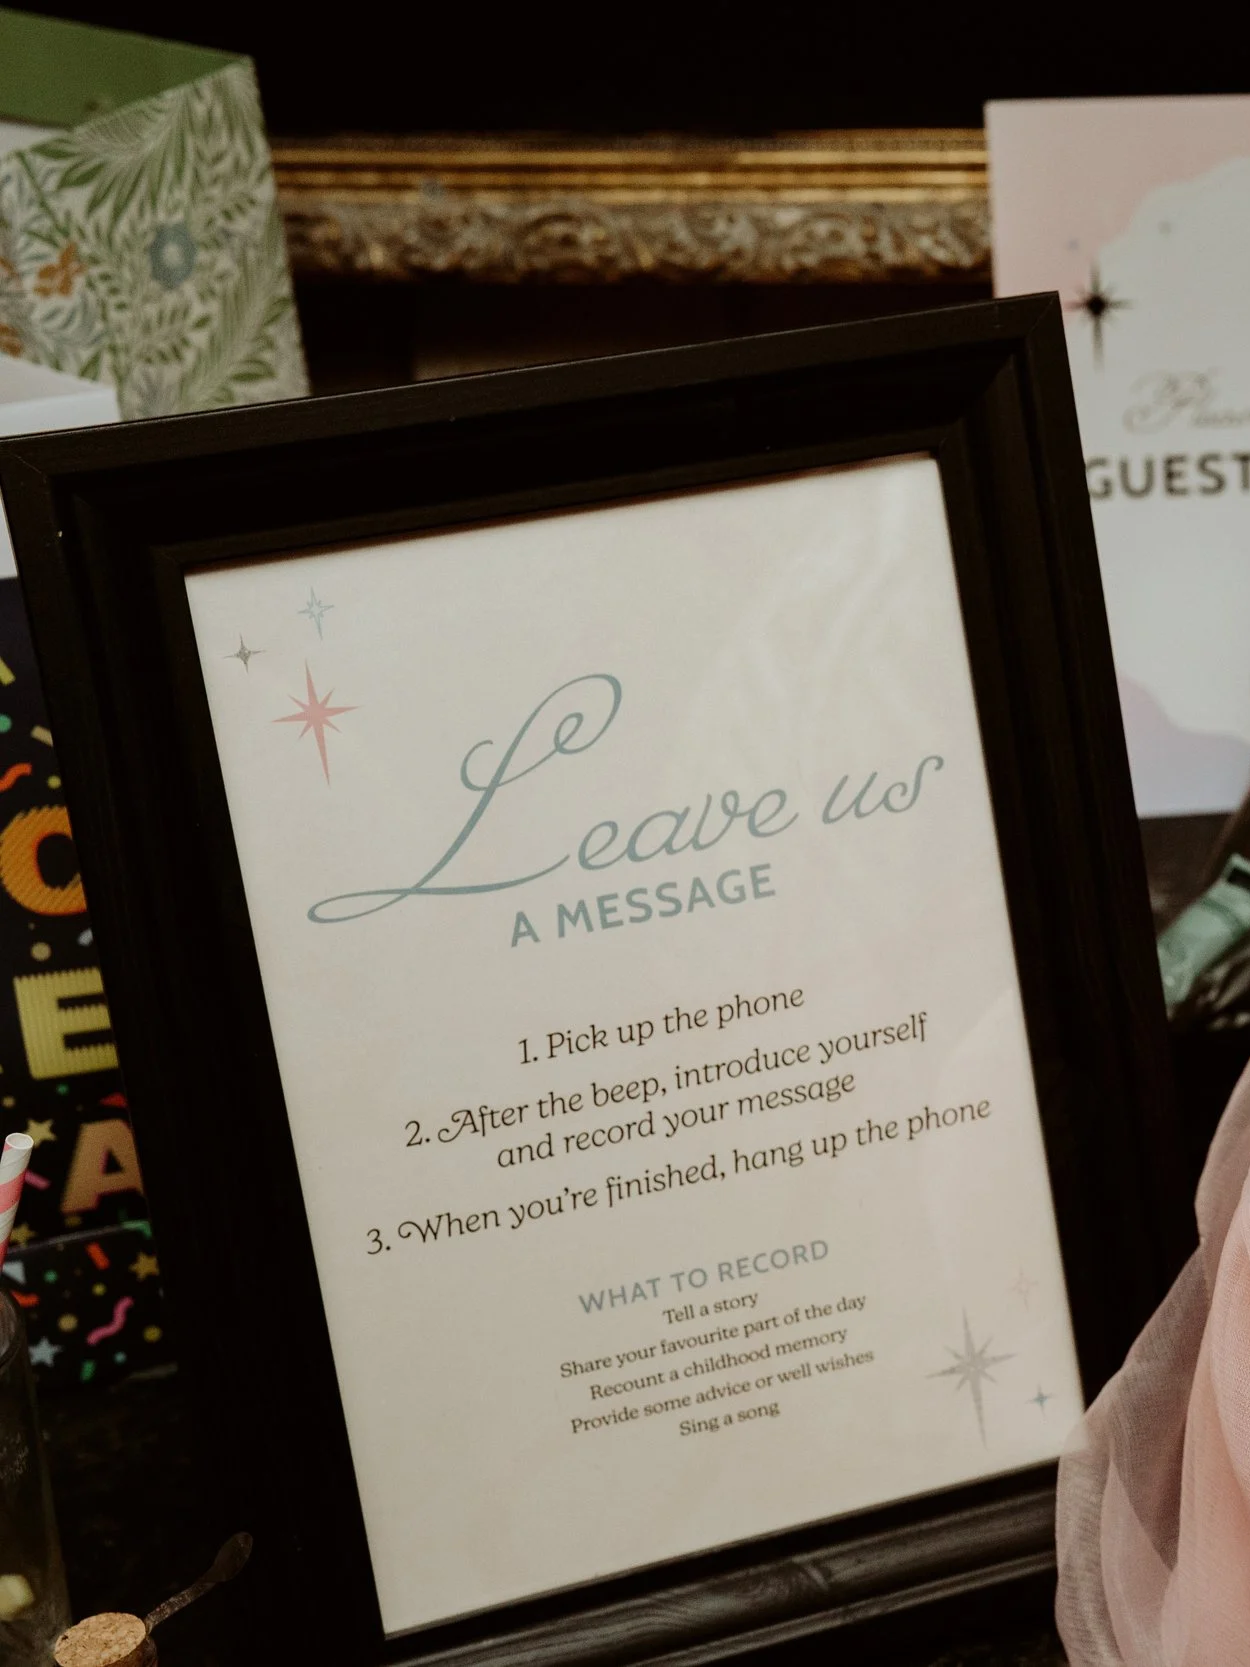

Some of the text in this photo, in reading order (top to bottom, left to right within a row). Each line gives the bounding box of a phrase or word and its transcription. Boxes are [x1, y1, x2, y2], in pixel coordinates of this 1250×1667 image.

[307, 673, 944, 925] Leave us
[511, 864, 776, 948] A MESSAGE
[518, 988, 805, 1065] 1. Pick up the phone
[404, 1011, 928, 1148] 2. After the beep, introduce yourself
[497, 1073, 856, 1168] and record your message
[366, 1100, 991, 1255] 3. When you're finished, hang up the phone
[578, 1240, 829, 1314] WHAT TO RECORD
[662, 1292, 758, 1325] Tell a story
[560, 1295, 866, 1378] Share your favourite part of the day
[589, 1328, 848, 1401] Recount a childhood memory
[570, 1351, 875, 1434] Provide some advice or well wishes
[679, 1402, 781, 1437] Sing a song
